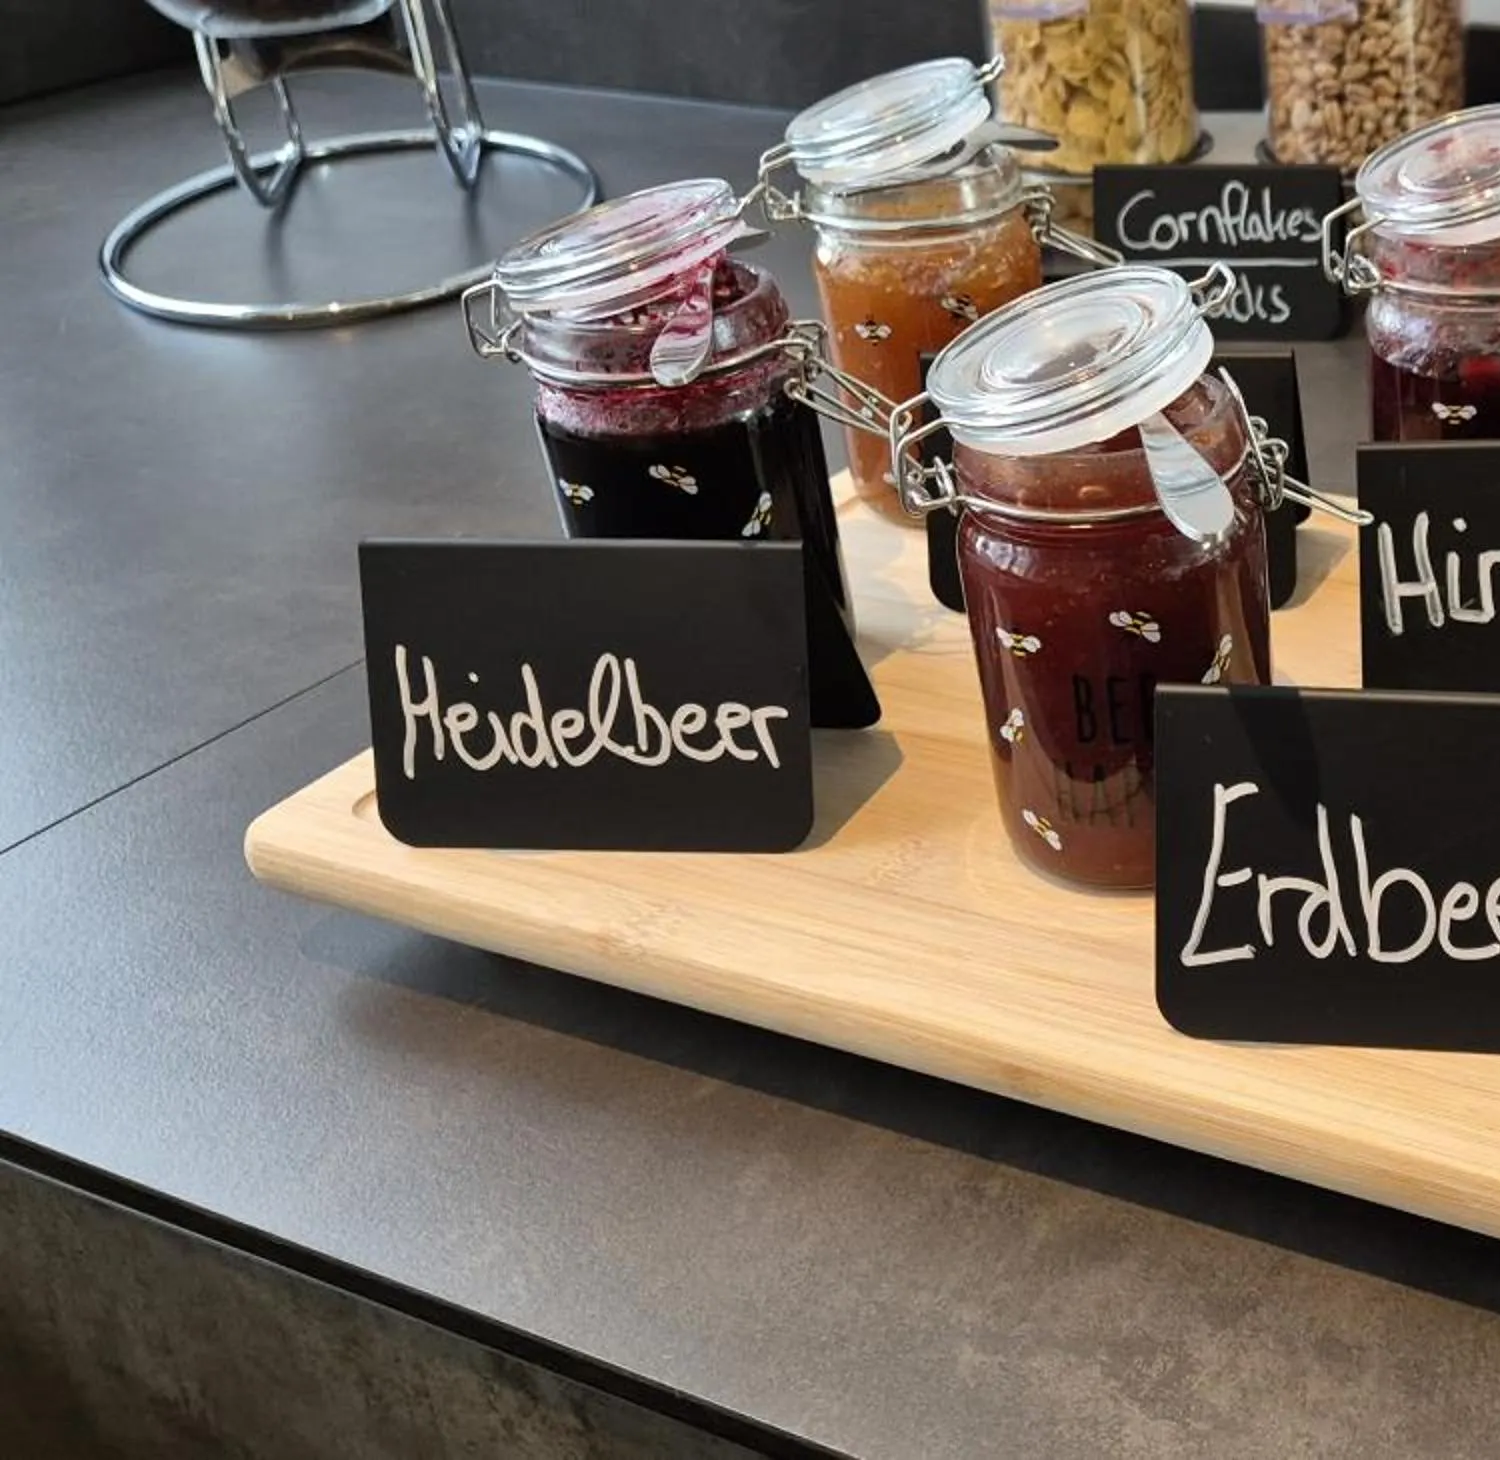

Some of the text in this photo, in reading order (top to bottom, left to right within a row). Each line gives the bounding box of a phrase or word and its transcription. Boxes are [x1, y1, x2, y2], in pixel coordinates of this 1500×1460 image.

[1116, 179, 1323, 250] Cornflakes
[394, 643, 789, 780] Heidelbeer
[1056, 759, 1145, 829] HAP
